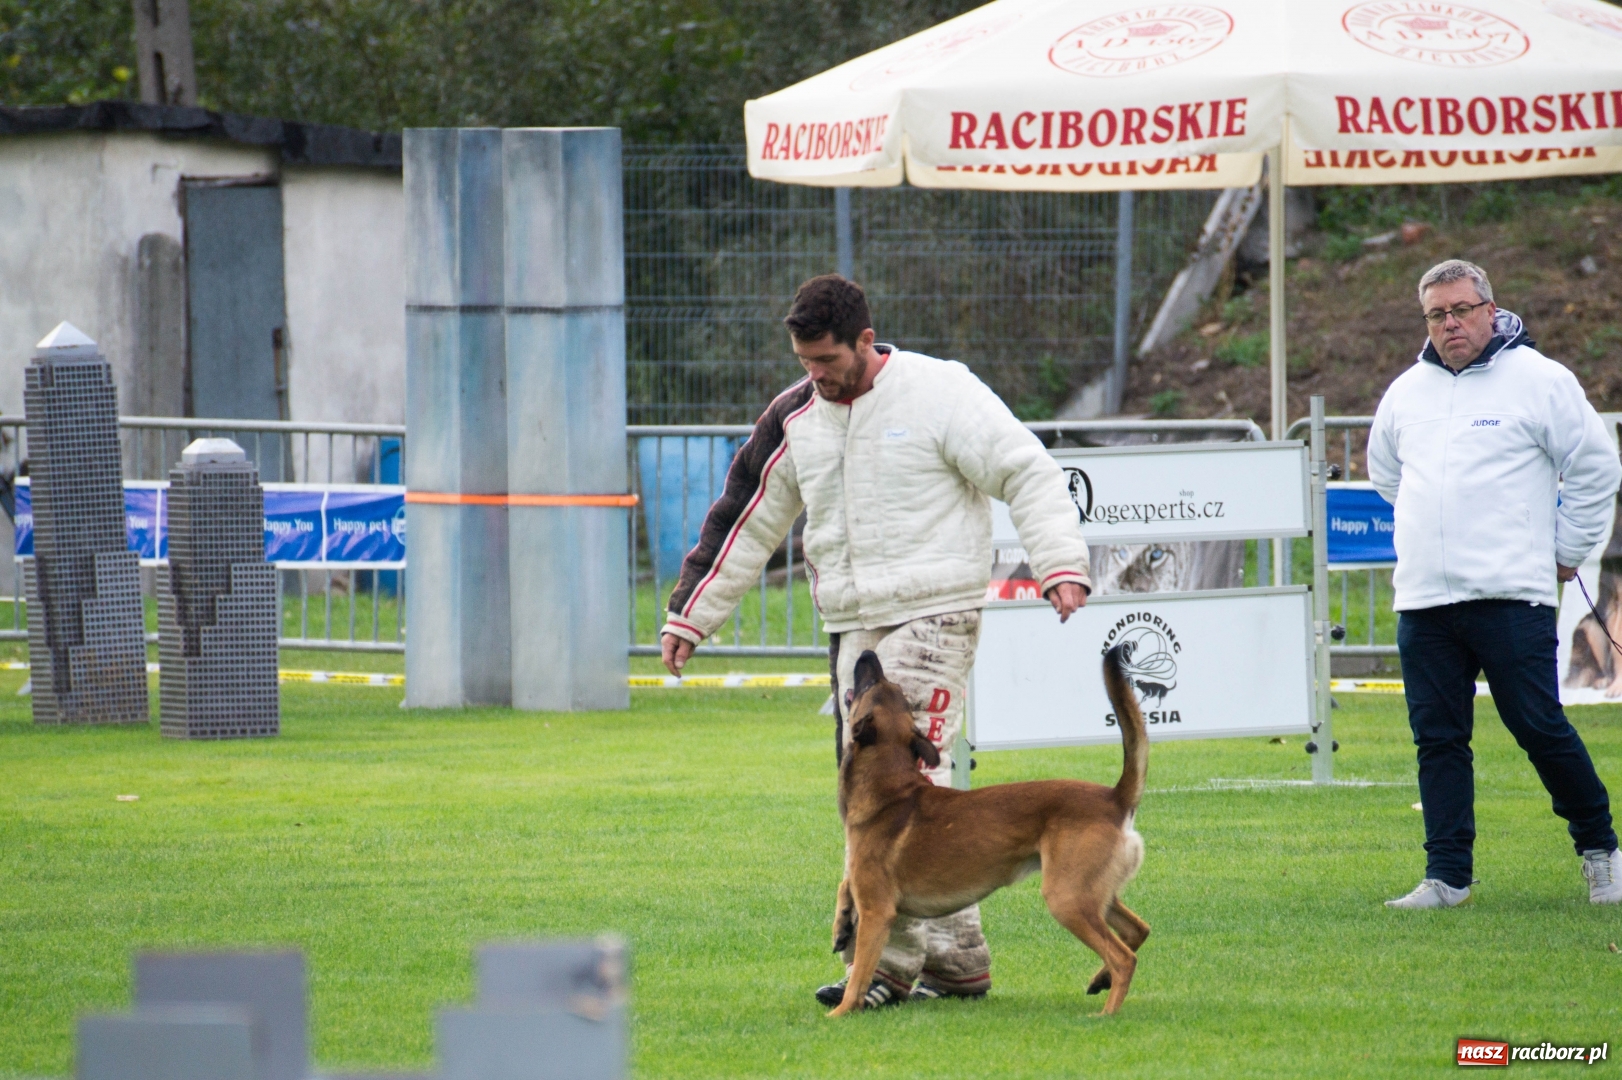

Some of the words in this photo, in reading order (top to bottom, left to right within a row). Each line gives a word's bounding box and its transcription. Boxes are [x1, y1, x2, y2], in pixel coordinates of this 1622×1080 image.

[949, 98, 1248, 150] RACIBORSKIE
[761, 114, 889, 160] RACIBORSKIE
[1471, 419, 1501, 427] JUDGE
[1179, 489, 1194, 499] shop
[294, 517, 314, 532] You
[333, 517, 366, 535] Happy
[369, 519, 387, 535] pet
[1331, 516, 1369, 535] Happy
[1371, 516, 1395, 532] You
[1101, 612, 1182, 656] MONDIORING
